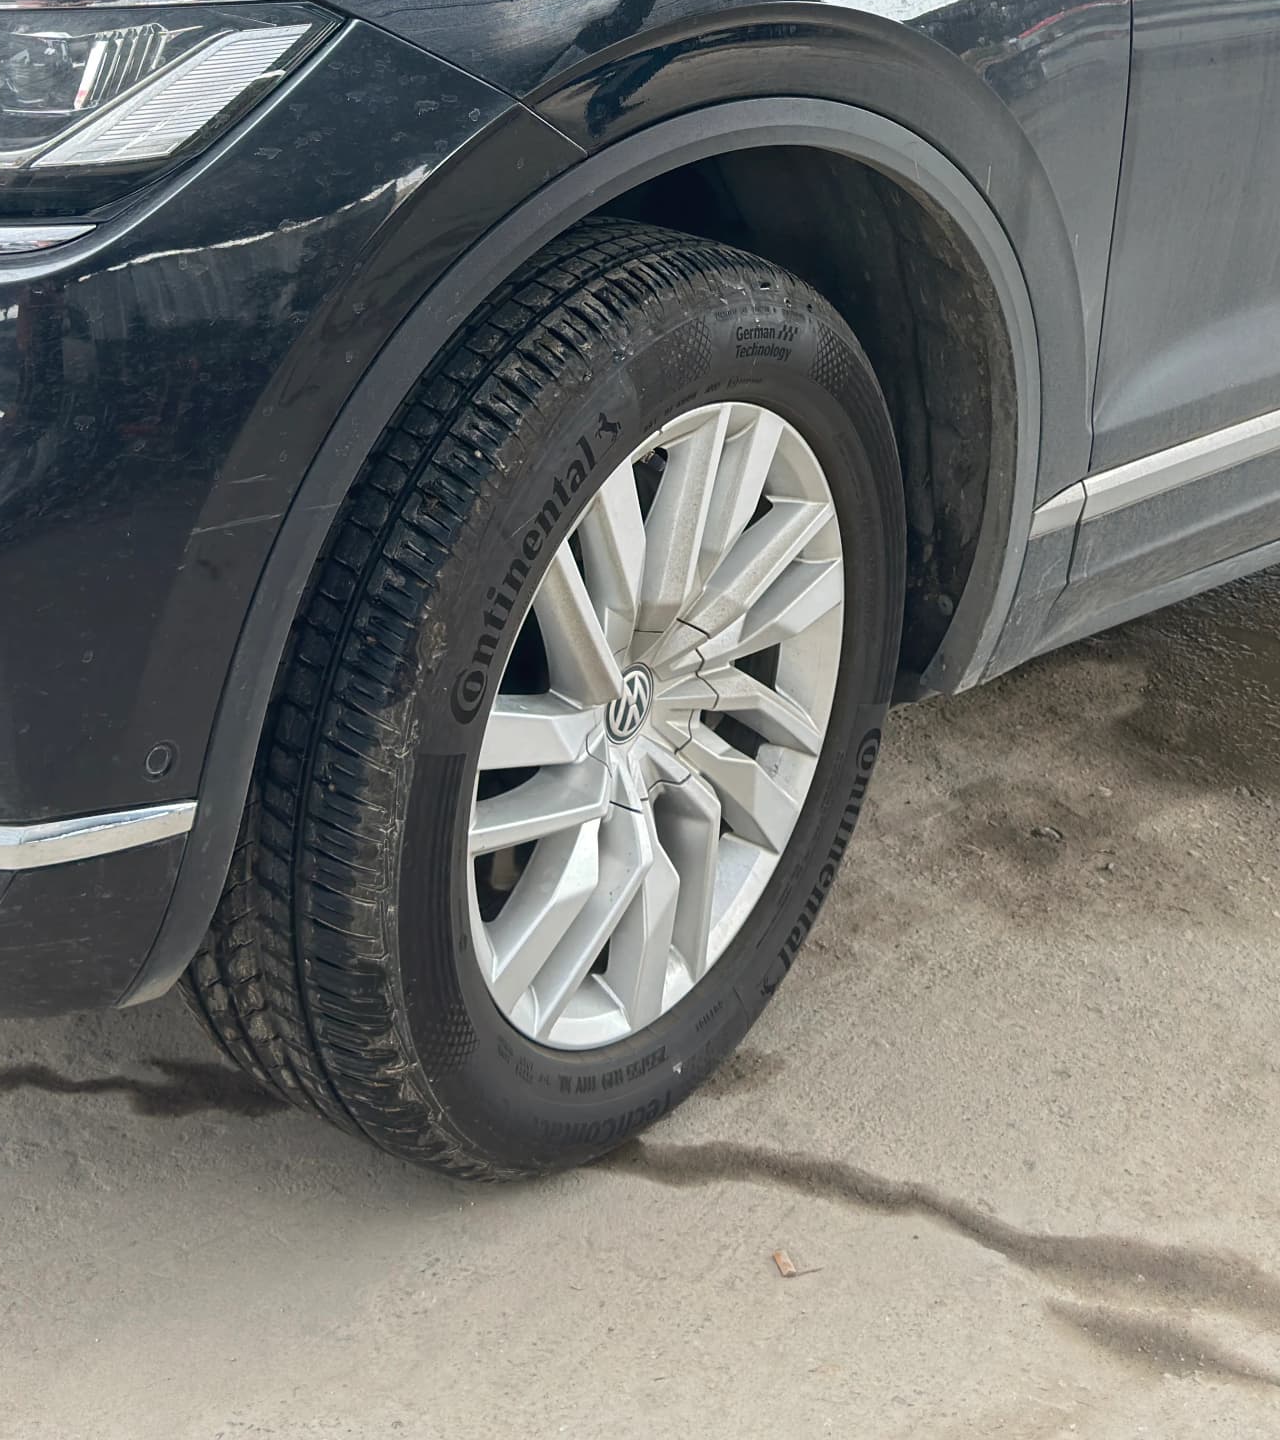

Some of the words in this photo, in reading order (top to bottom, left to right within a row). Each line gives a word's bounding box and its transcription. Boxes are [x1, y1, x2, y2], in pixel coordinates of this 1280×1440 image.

[735, 325, 776, 343] German
[735, 343, 792, 362] Technology
[450, 434, 597, 725] Continental
